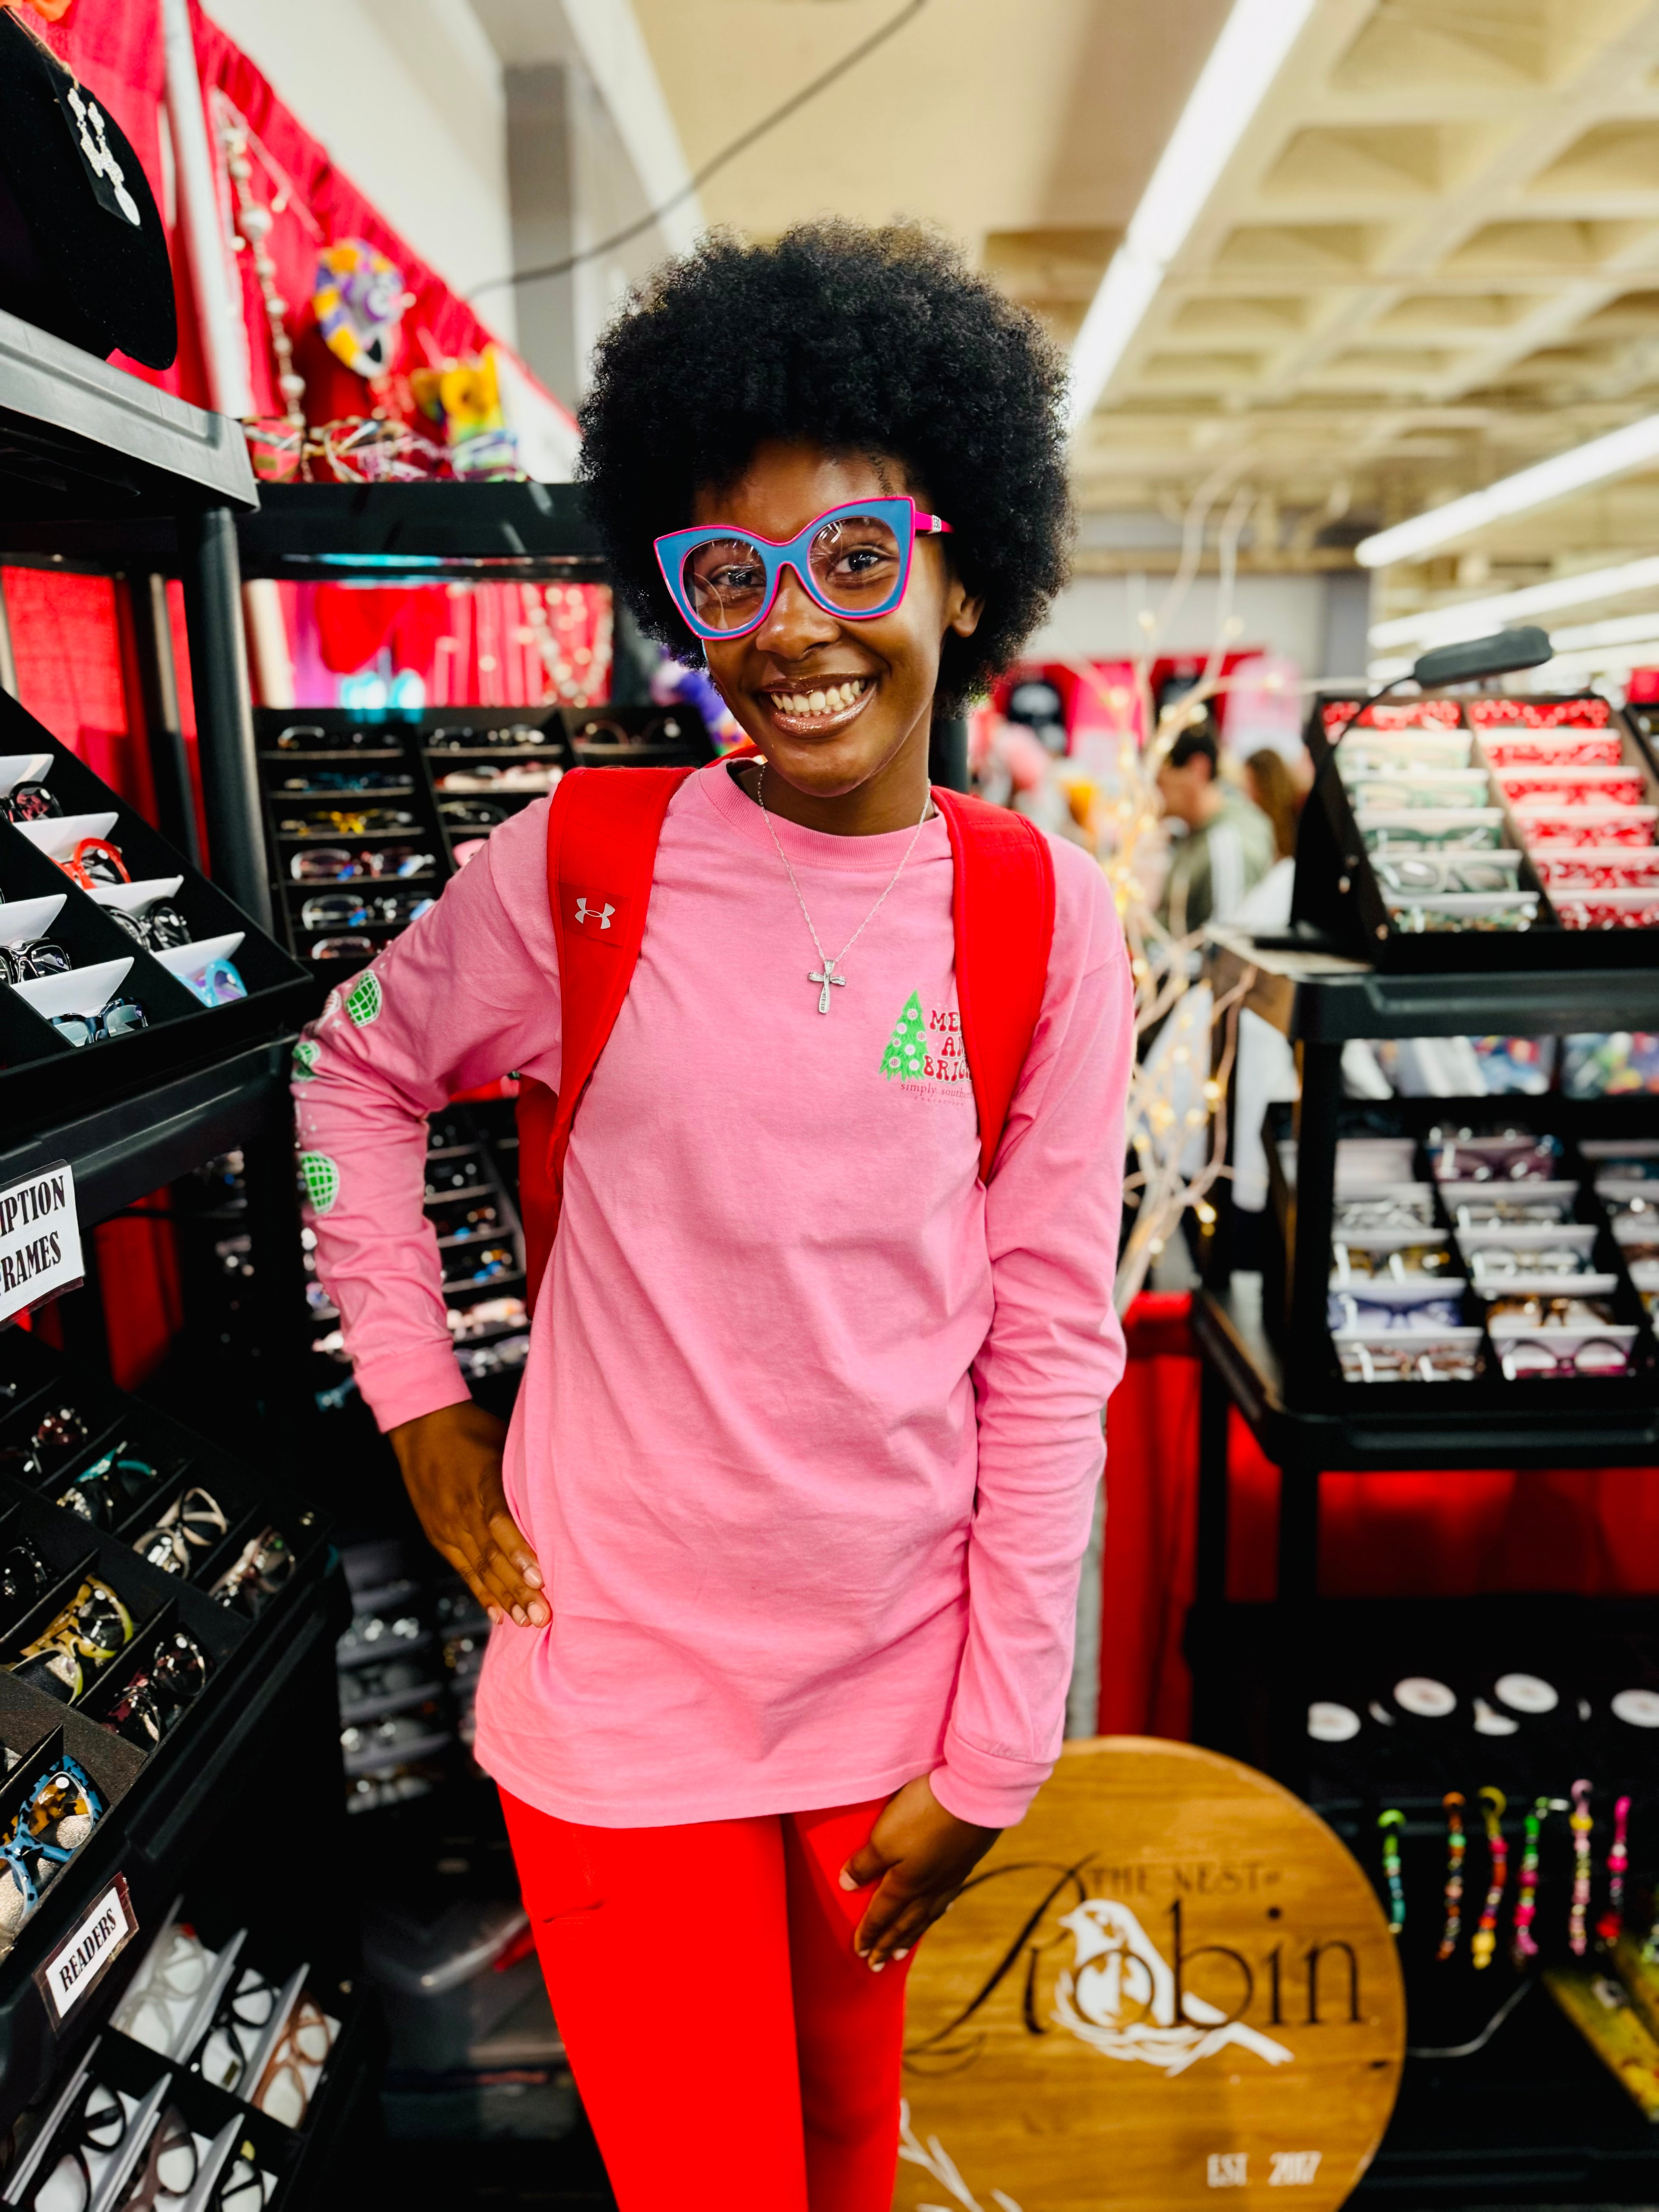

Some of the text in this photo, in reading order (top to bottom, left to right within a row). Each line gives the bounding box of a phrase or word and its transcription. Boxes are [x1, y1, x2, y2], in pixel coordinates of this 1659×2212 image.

[930, 1010, 960, 1032] ME
[901, 1081, 937, 1097] simply
[0, 1230, 61, 1296] RAMES
[1086, 1865, 1154, 1896] THE
[1173, 1860, 1263, 1895] NEST
[59, 1908, 117, 1993] READERS
